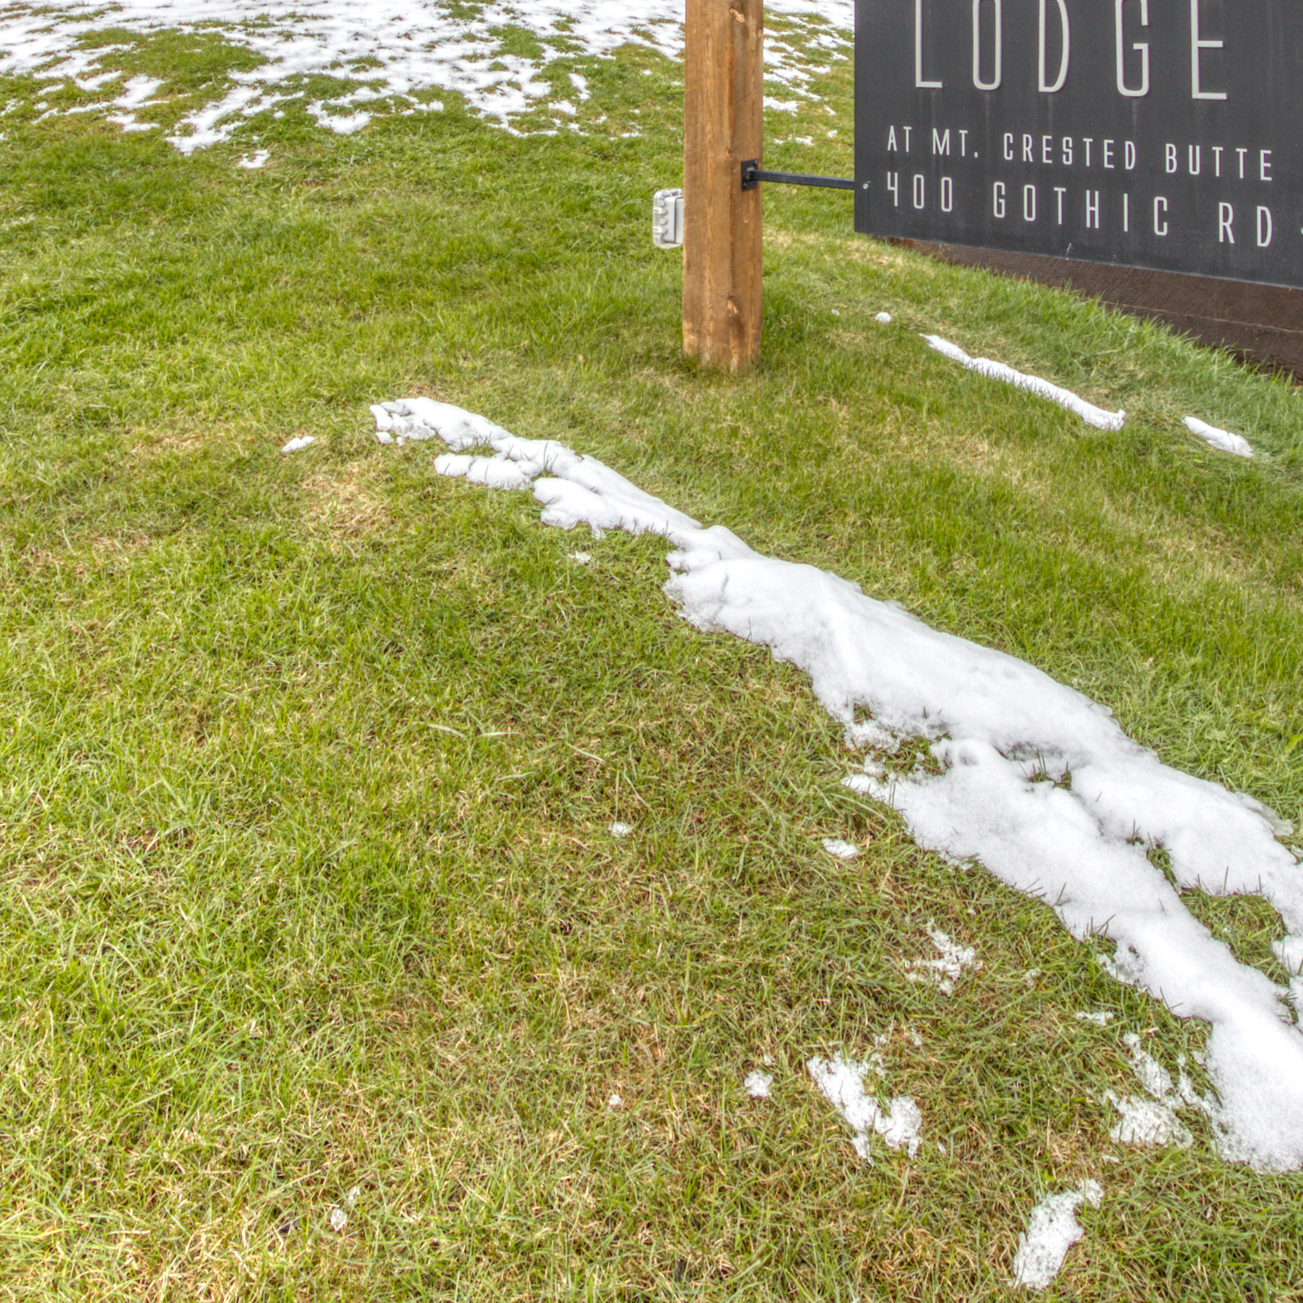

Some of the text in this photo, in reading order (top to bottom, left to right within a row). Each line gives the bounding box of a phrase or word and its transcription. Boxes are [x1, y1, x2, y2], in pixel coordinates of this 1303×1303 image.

[887, 125, 1273, 182] AT MT. CRESTED BUTTE
[887, 175, 1273, 248] 400 GOTHIC RD
